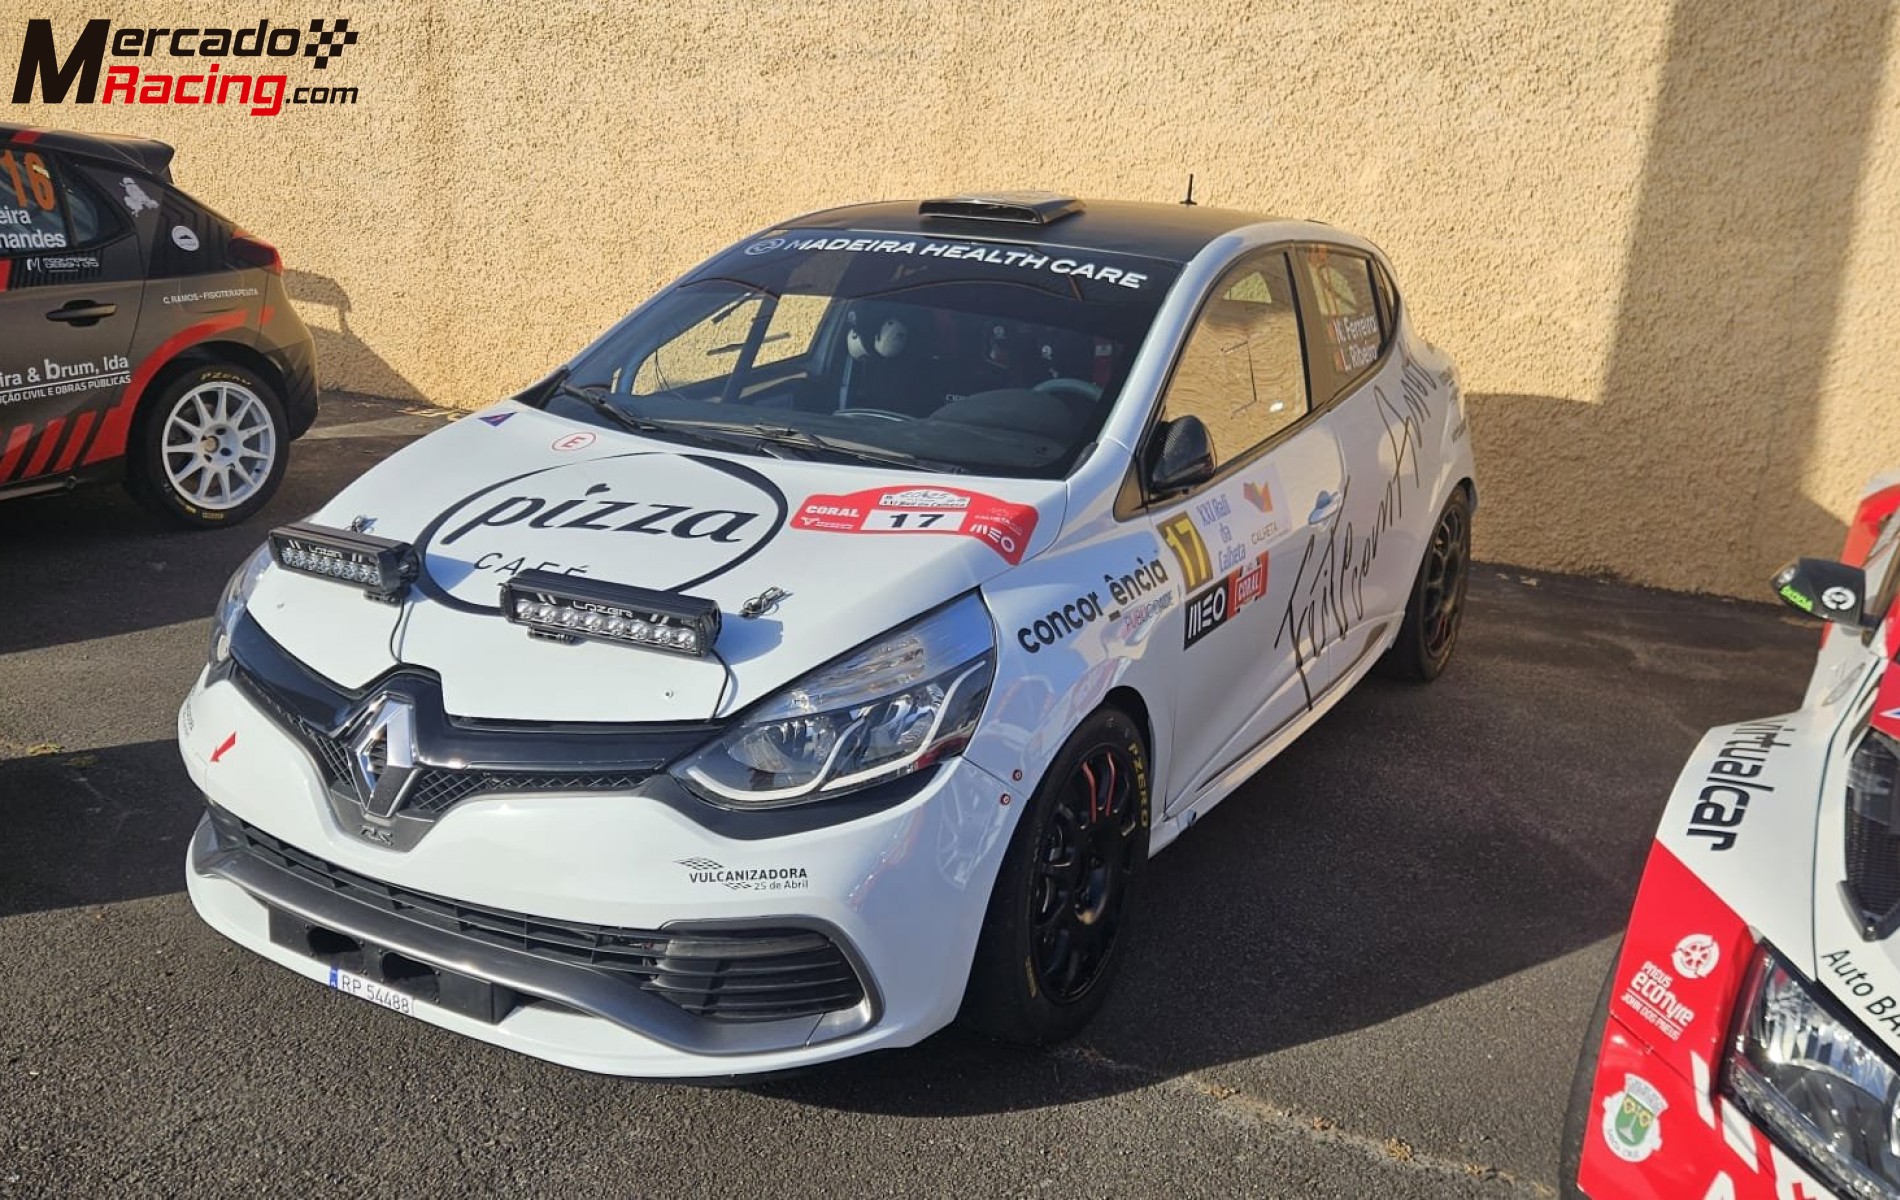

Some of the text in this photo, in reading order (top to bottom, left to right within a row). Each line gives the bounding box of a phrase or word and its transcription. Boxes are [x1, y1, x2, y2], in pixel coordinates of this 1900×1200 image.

[0, 149, 56, 212] 16
[784, 238, 1148, 289] MADEIRA HEALTH CARE
[27, 367, 41, 383] &
[43, 358, 100, 380] brum,
[103, 355, 129, 371] lda
[23, 389, 47, 401] CIVIL
[48, 387, 54, 396] E
[55, 382, 87, 395] OBRAS
[439, 483, 760, 545] pizza
[805, 505, 860, 518] CORAL
[890, 514, 945, 529] 17
[969, 524, 1015, 553] MEO
[1165, 518, 1207, 588] 17
[1187, 586, 1226, 641] MEO
[689, 868, 808, 883] VULCANIZADORA
[754, 880, 809, 891] 25 de Abril
[342, 973, 361, 994] RP
[1821, 950, 1900, 1038] Auto BA
